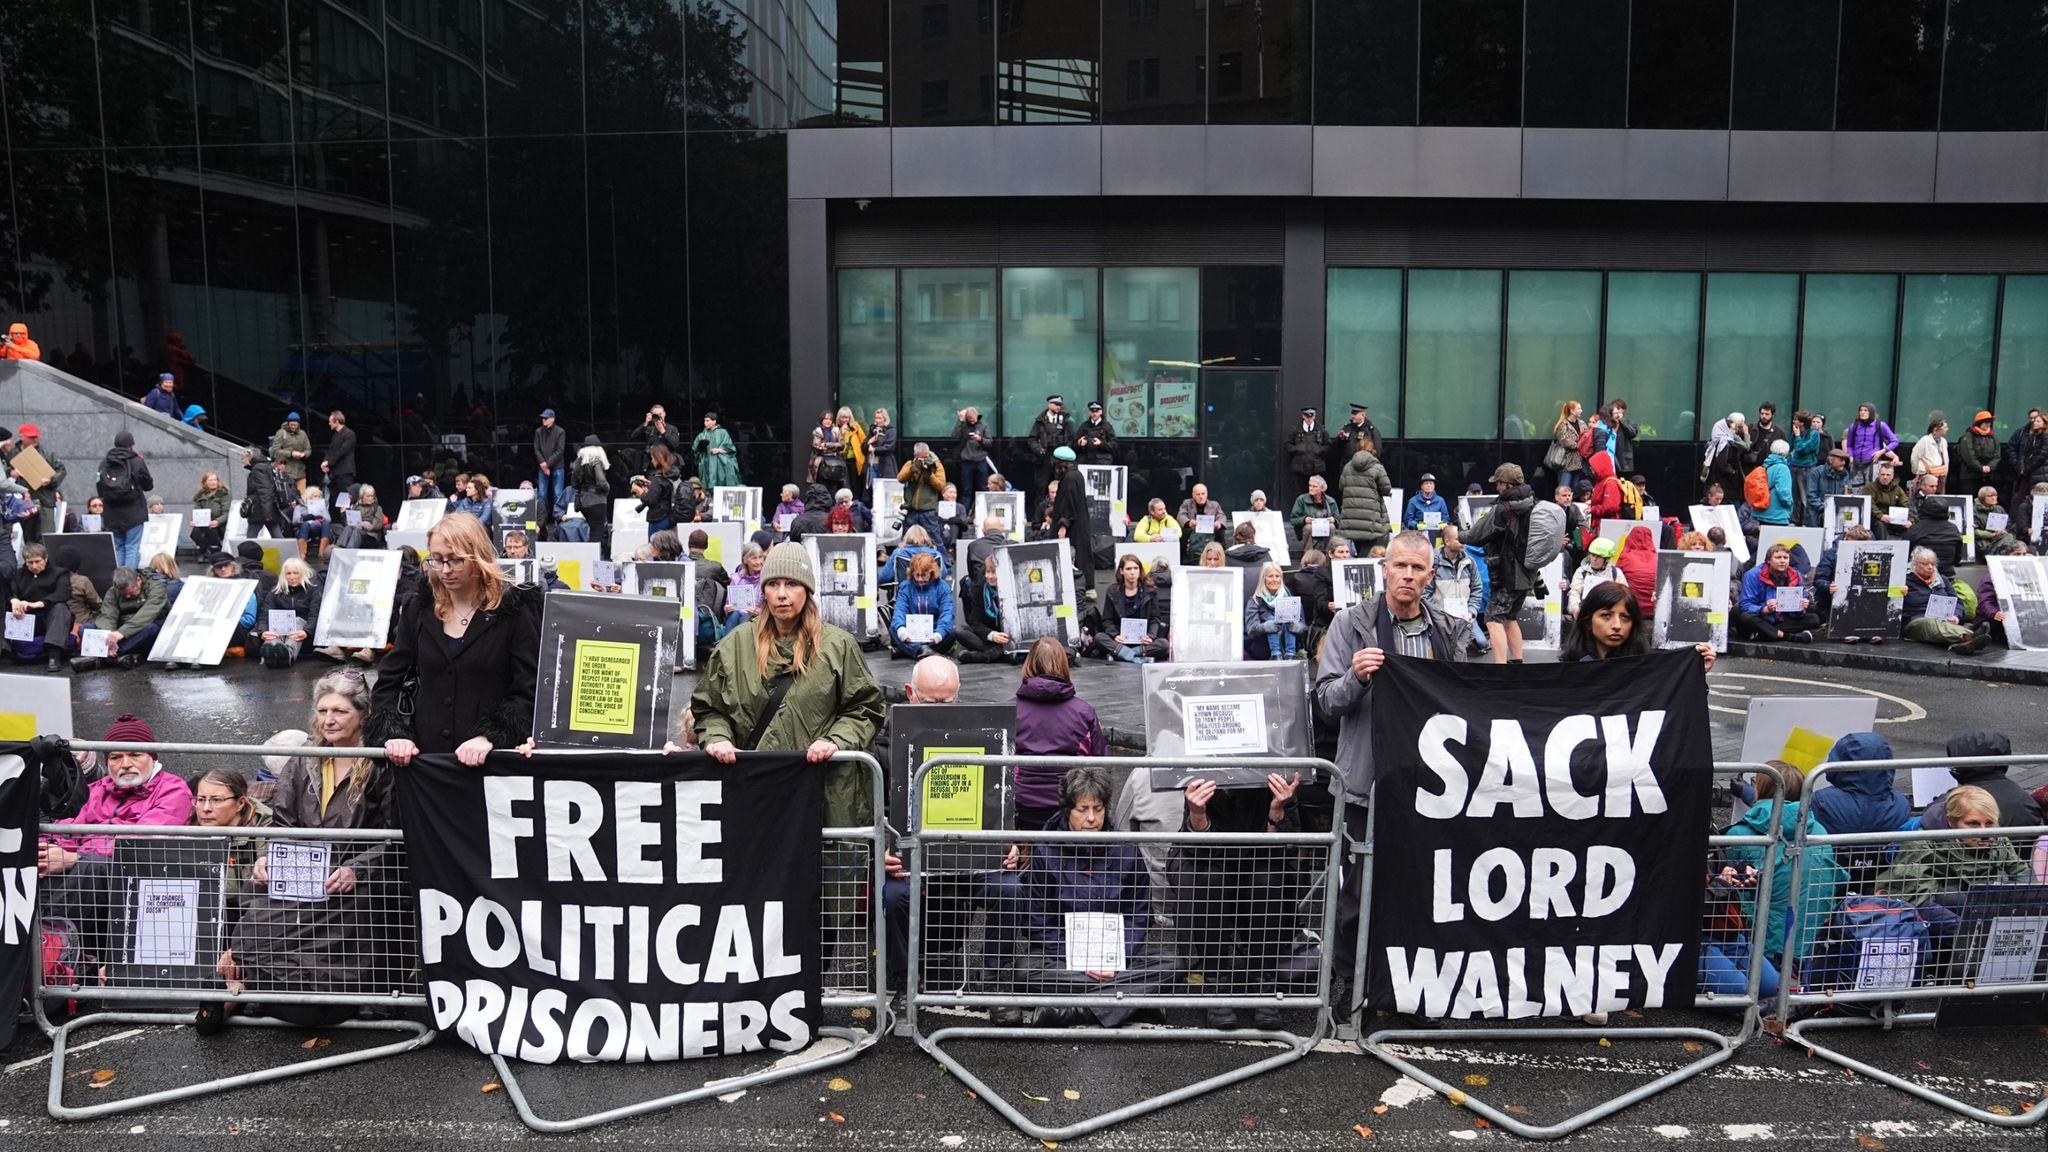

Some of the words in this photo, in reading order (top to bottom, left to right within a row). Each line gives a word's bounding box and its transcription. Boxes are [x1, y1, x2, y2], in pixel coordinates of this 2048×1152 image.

[1414, 710, 1668, 820] SACK
[483, 775, 723, 884] FREE
[1433, 845, 1636, 923] LORD
[419, 888, 802, 985] POLITICAL
[1386, 943, 1683, 1019] WALNEY
[428, 979, 811, 1064] PRISONERS
